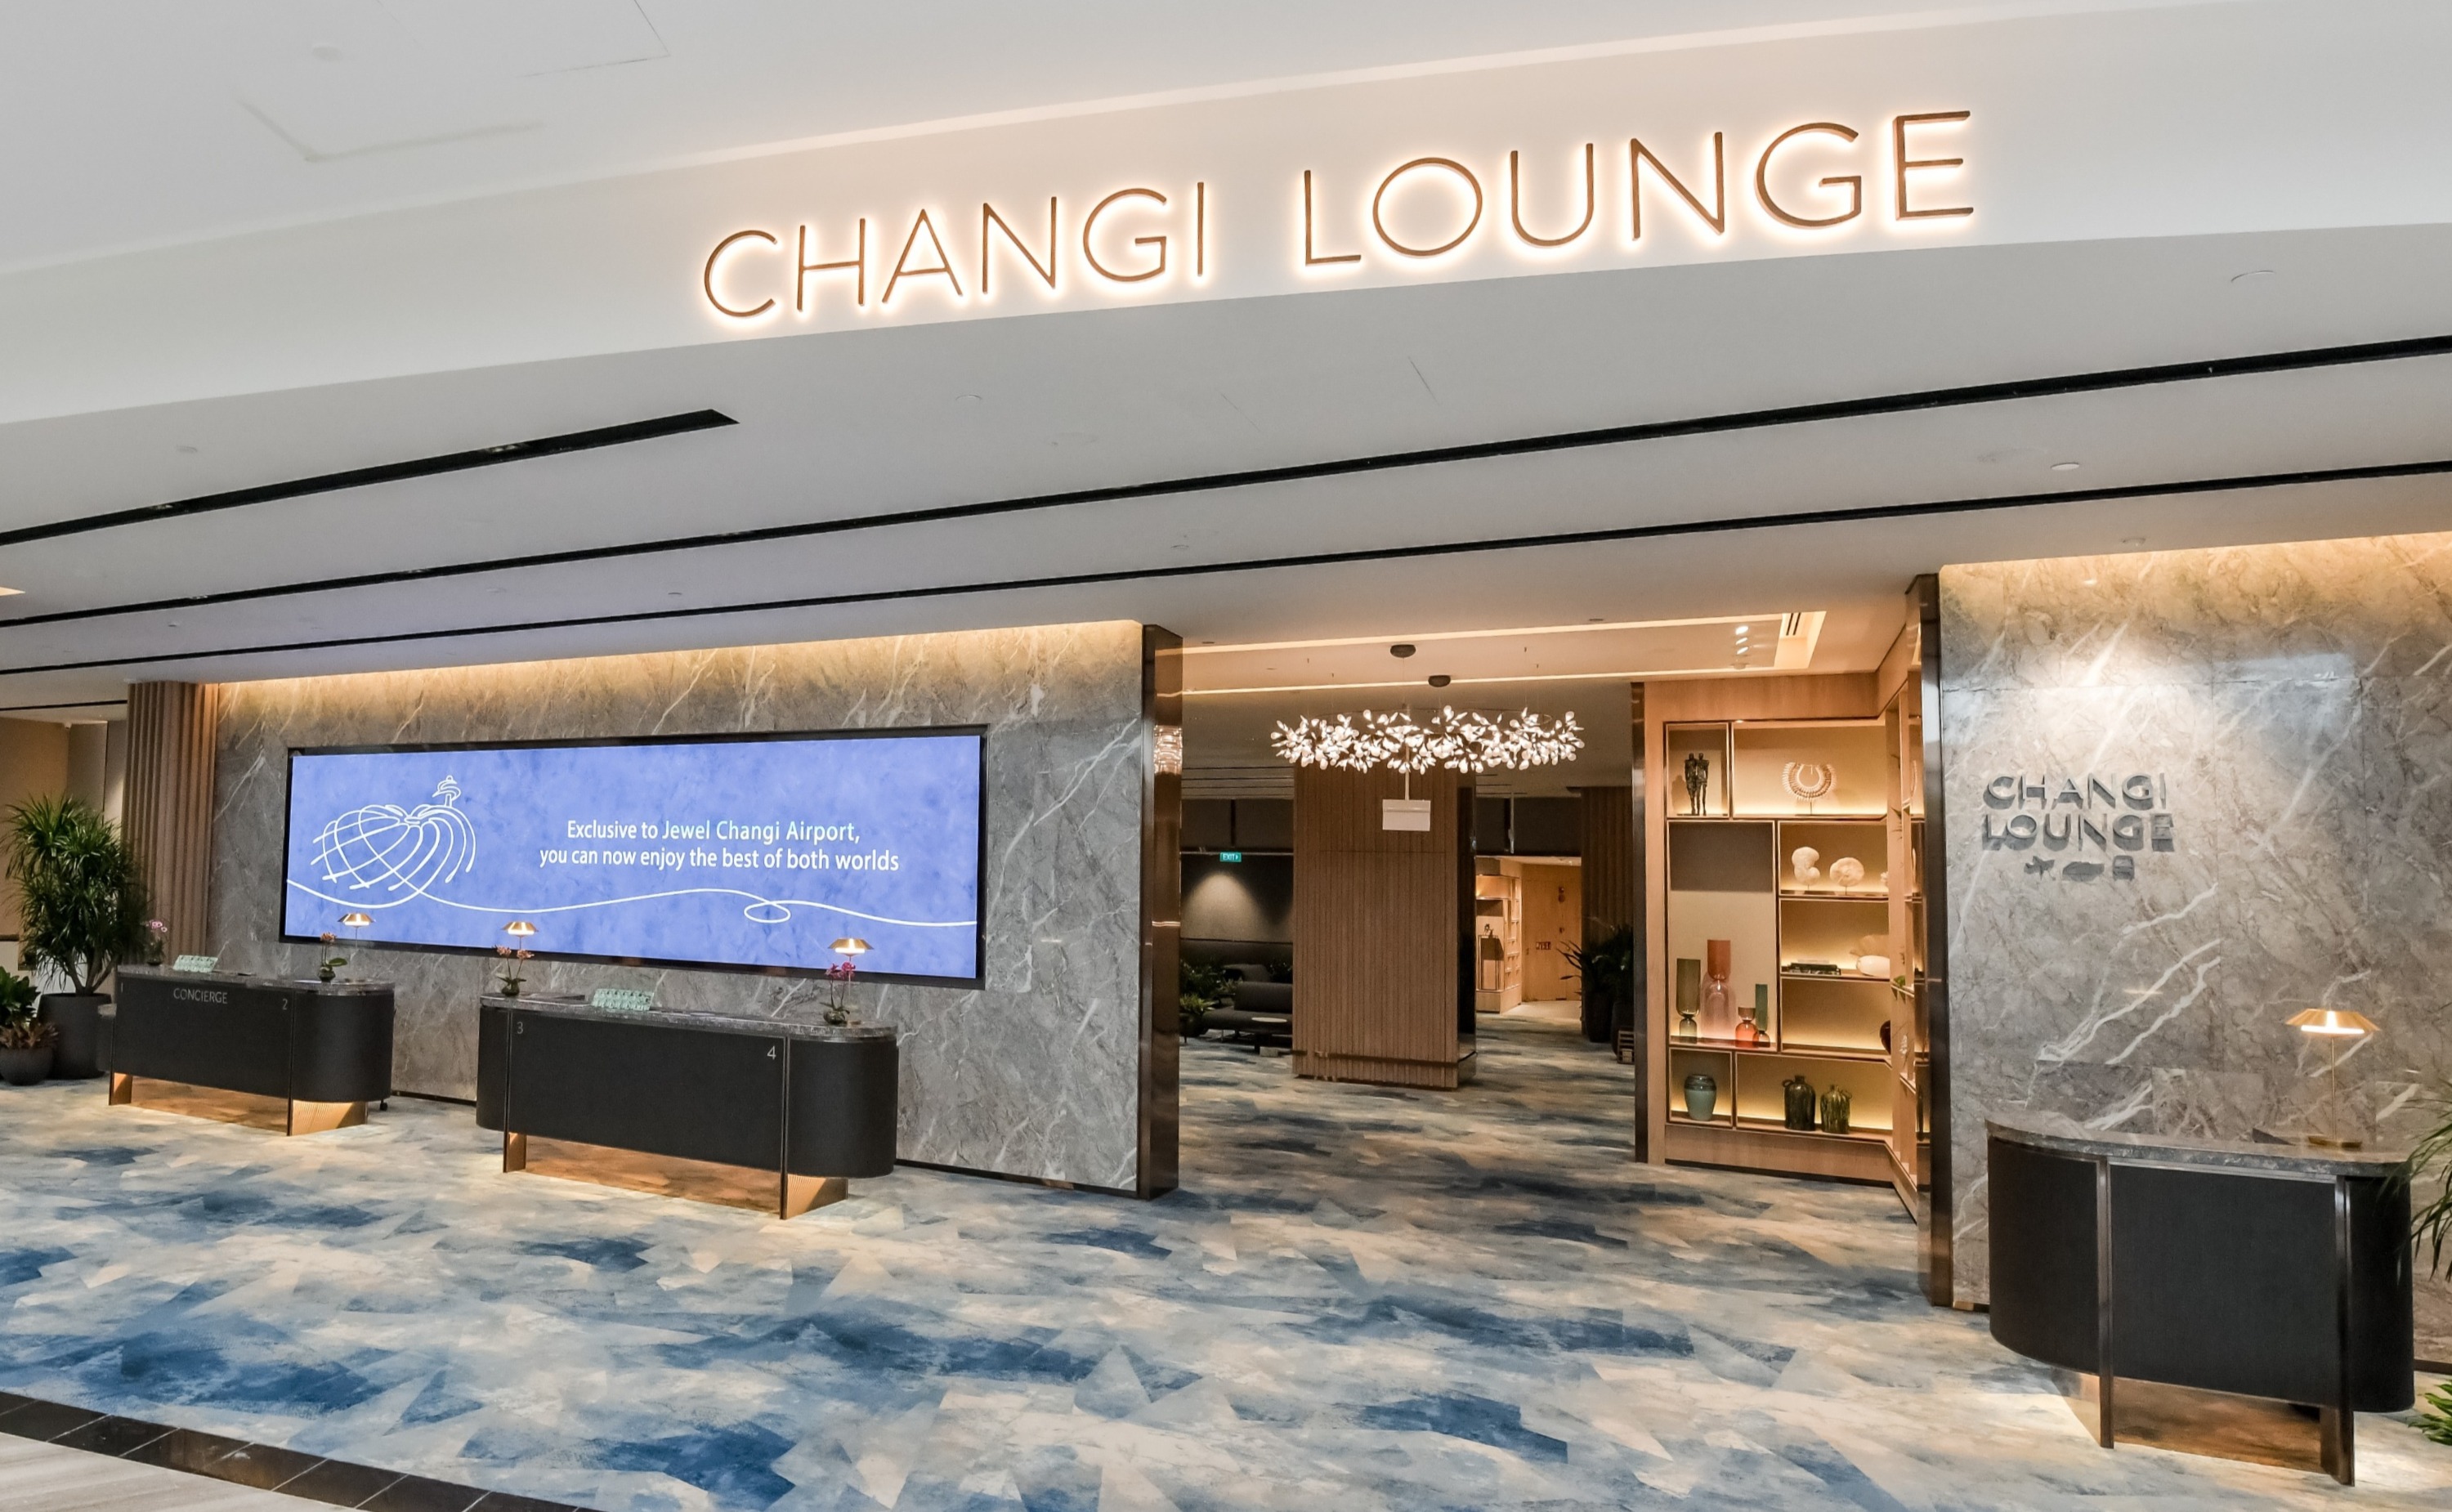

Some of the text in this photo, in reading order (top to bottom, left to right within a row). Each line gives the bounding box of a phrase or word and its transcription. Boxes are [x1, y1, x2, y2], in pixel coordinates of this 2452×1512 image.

[704, 110, 1975, 319] CHANGI LOUNGE
[1985, 772, 2166, 805] CHANGI
[567, 820, 861, 845] Exclusive to Jewel Changi Airport,
[1984, 812, 2174, 846] LOUNGE
[539, 847, 900, 871] you can now enjoy the best of both worlds
[172, 987, 228, 1004] CONCIERGE
[282, 998, 289, 1010] 2
[517, 1022, 524, 1035] 3
[767, 1045, 776, 1060] 4
